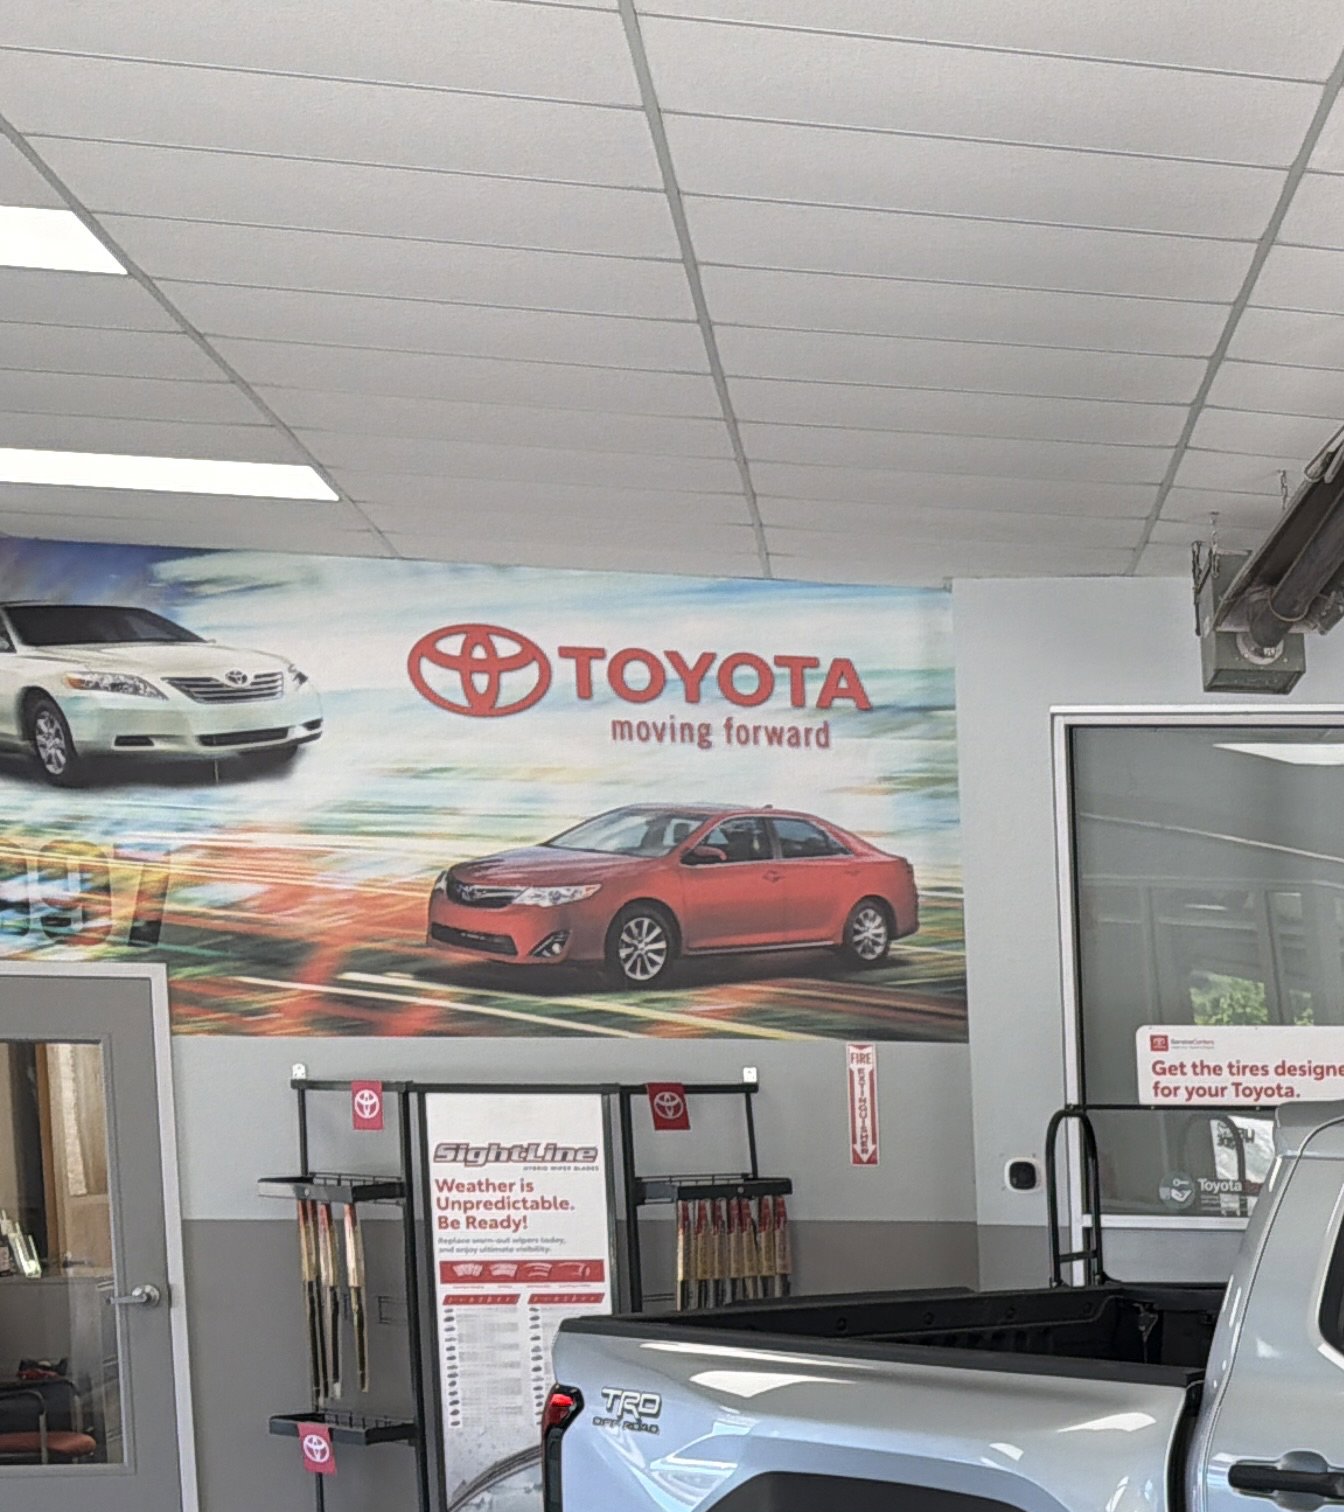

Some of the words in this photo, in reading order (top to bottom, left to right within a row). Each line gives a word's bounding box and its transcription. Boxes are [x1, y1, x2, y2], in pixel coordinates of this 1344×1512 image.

[557, 646, 873, 711] TOYOTA
[611, 714, 712, 750] moving
[724, 716, 831, 750] forward
[850, 1052, 872, 1065] FIRE
[1151, 1059, 1187, 1077] Get
[1191, 1059, 1223, 1077] the
[1227, 1059, 1270, 1077] tires
[1152, 1081, 1176, 1098] for
[1184, 1085, 1227, 1103] your
[1231, 1081, 1301, 1103] Toyota.
[432, 1142, 599, 1168] SightLine
[434, 1177, 516, 1193] Weather
[519, 1177, 535, 1193] is
[1197, 1177, 1243, 1195] Toyota
[436, 1195, 575, 1214] Unpredictable.
[437, 1215, 461, 1230] Be
[465, 1214, 529, 1233] Ready!
[601, 1386, 662, 1421] TRD
